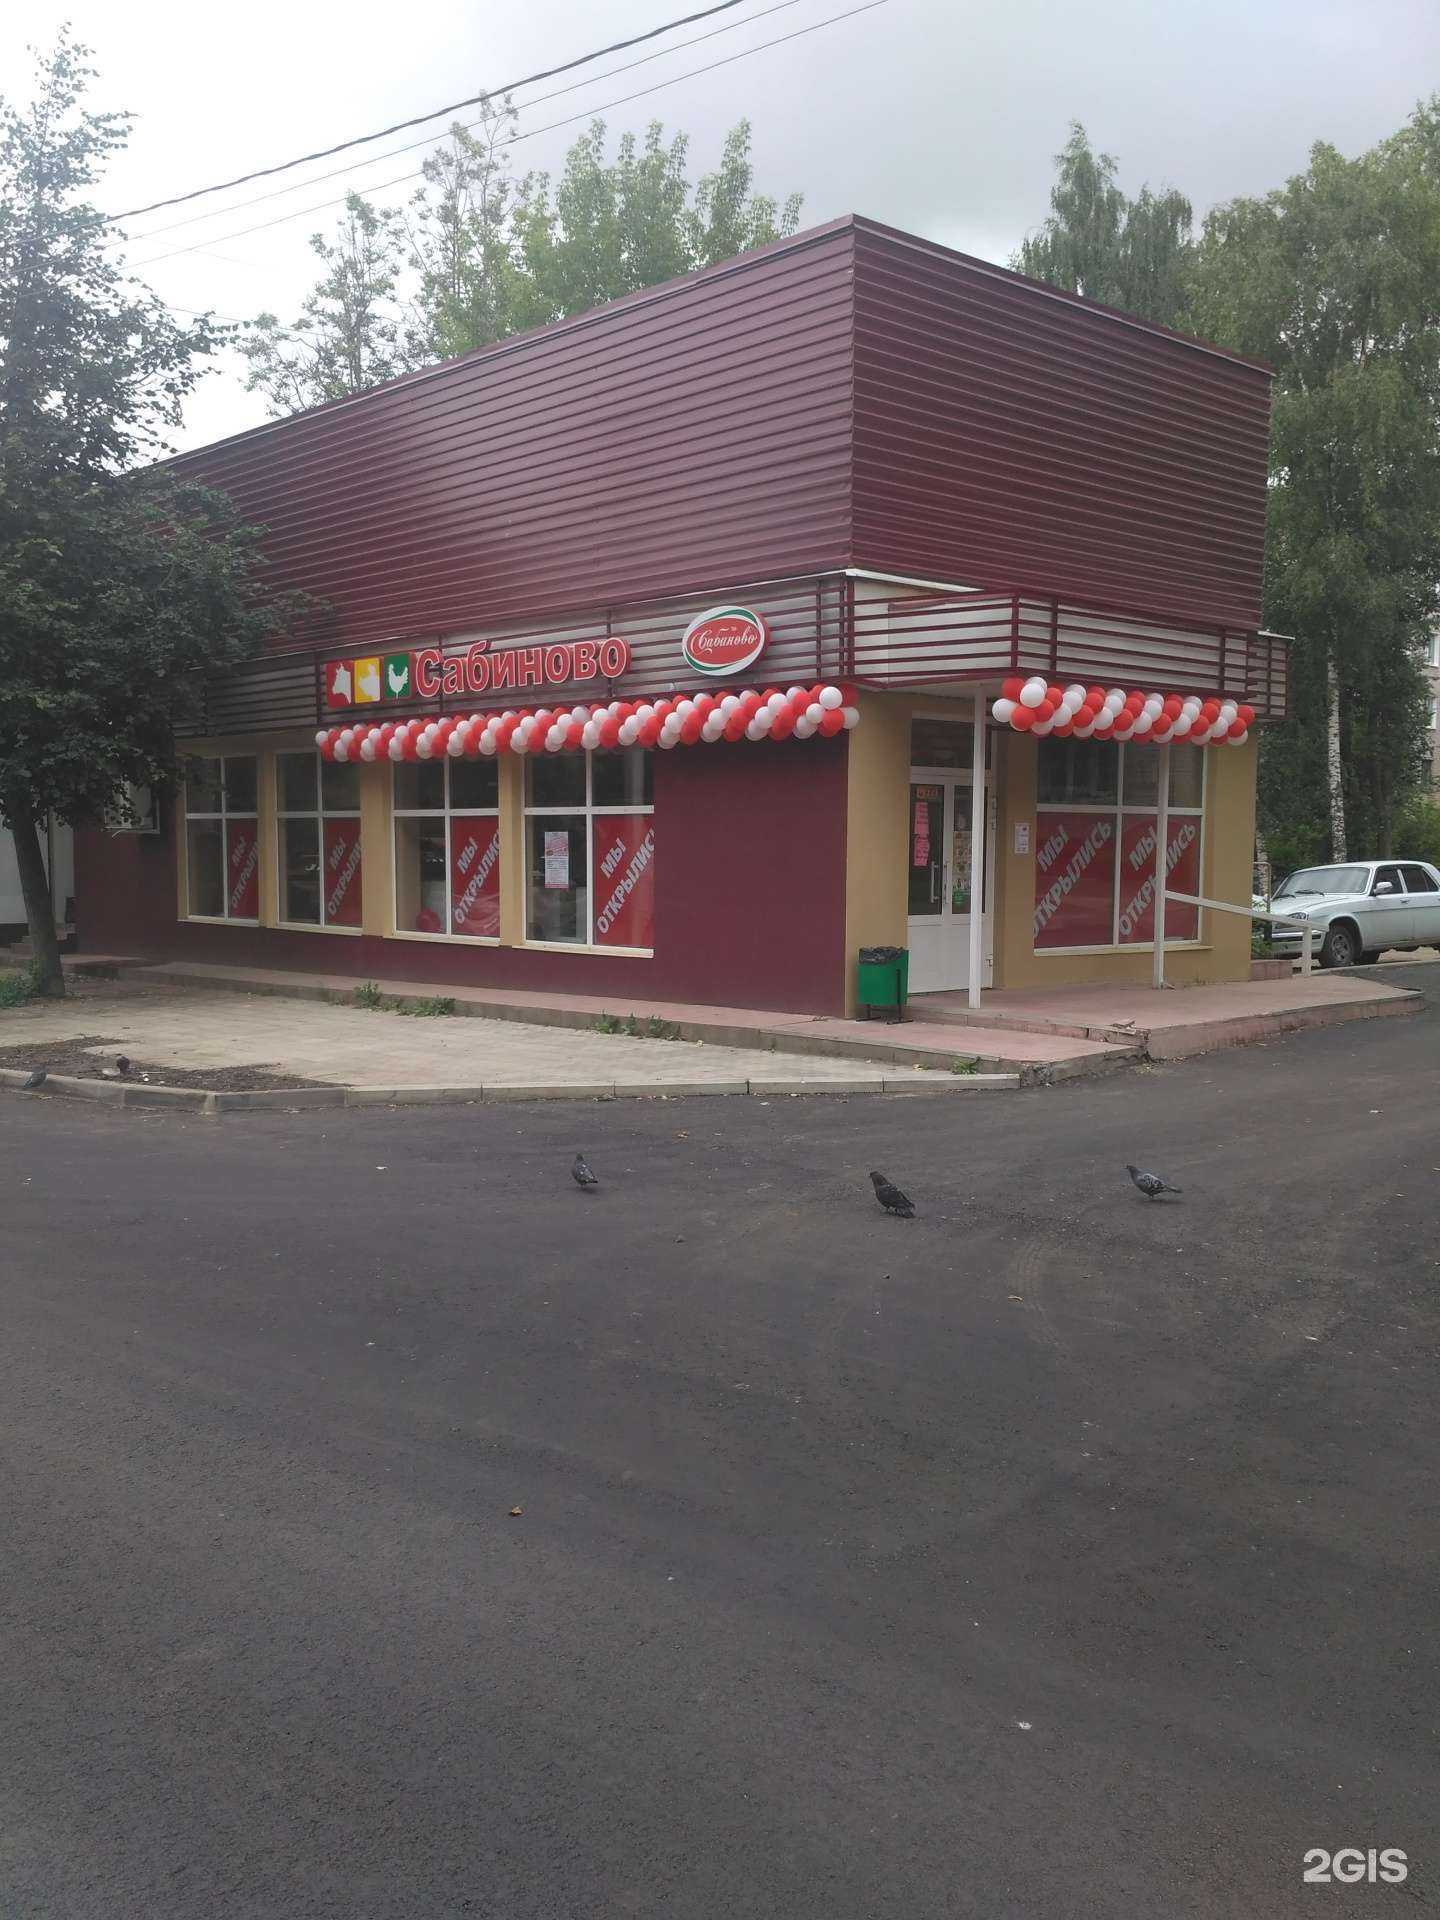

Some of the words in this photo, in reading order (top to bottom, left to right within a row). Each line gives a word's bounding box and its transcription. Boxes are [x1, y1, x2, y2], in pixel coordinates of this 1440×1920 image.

[690, 625, 758, 656] Сабиново
[416, 637, 630, 698] Сабиново
[457, 836, 478, 875] МЫ
[600, 837, 626, 879] МЫ
[1037, 824, 1069, 873] МЫ
[1129, 826, 1159, 872] МЫ
[597, 827, 655, 934] ОТКРЫЛИС
